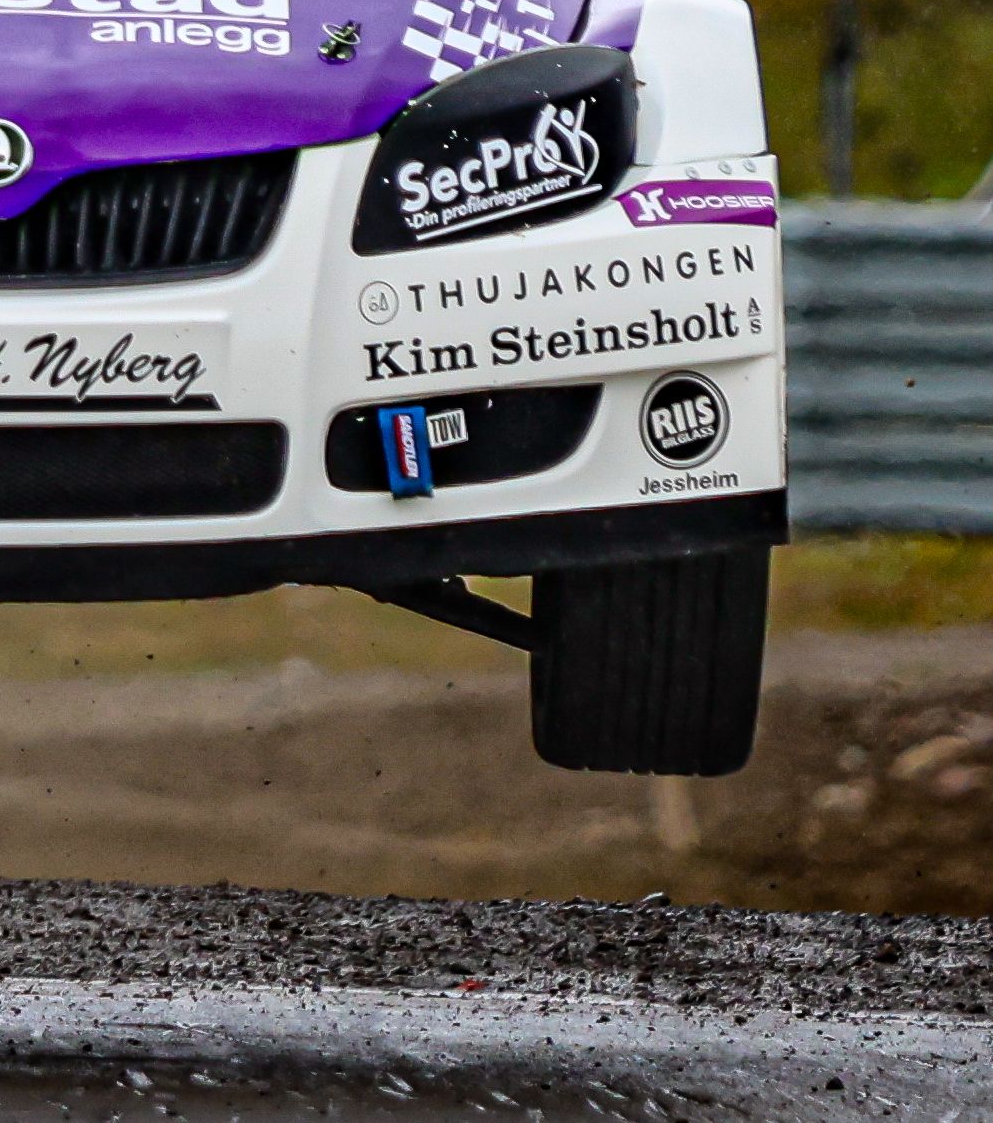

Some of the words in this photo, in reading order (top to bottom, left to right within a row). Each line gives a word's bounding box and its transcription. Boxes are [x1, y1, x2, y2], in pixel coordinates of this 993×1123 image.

[90, 17, 291, 55] anlegg
[398, 137, 562, 212] SecPro
[667, 195, 774, 211] HOOSIER
[408, 244, 754, 312] THUJAKONGEN
[363, 339, 477, 381] Kim
[490, 302, 740, 366] Steinsholt
[24, 333, 207, 402] Nyberg
[429, 412, 462, 444] TOW
[650, 394, 715, 440] RIIS
[638, 470, 739, 496] Jessheim
